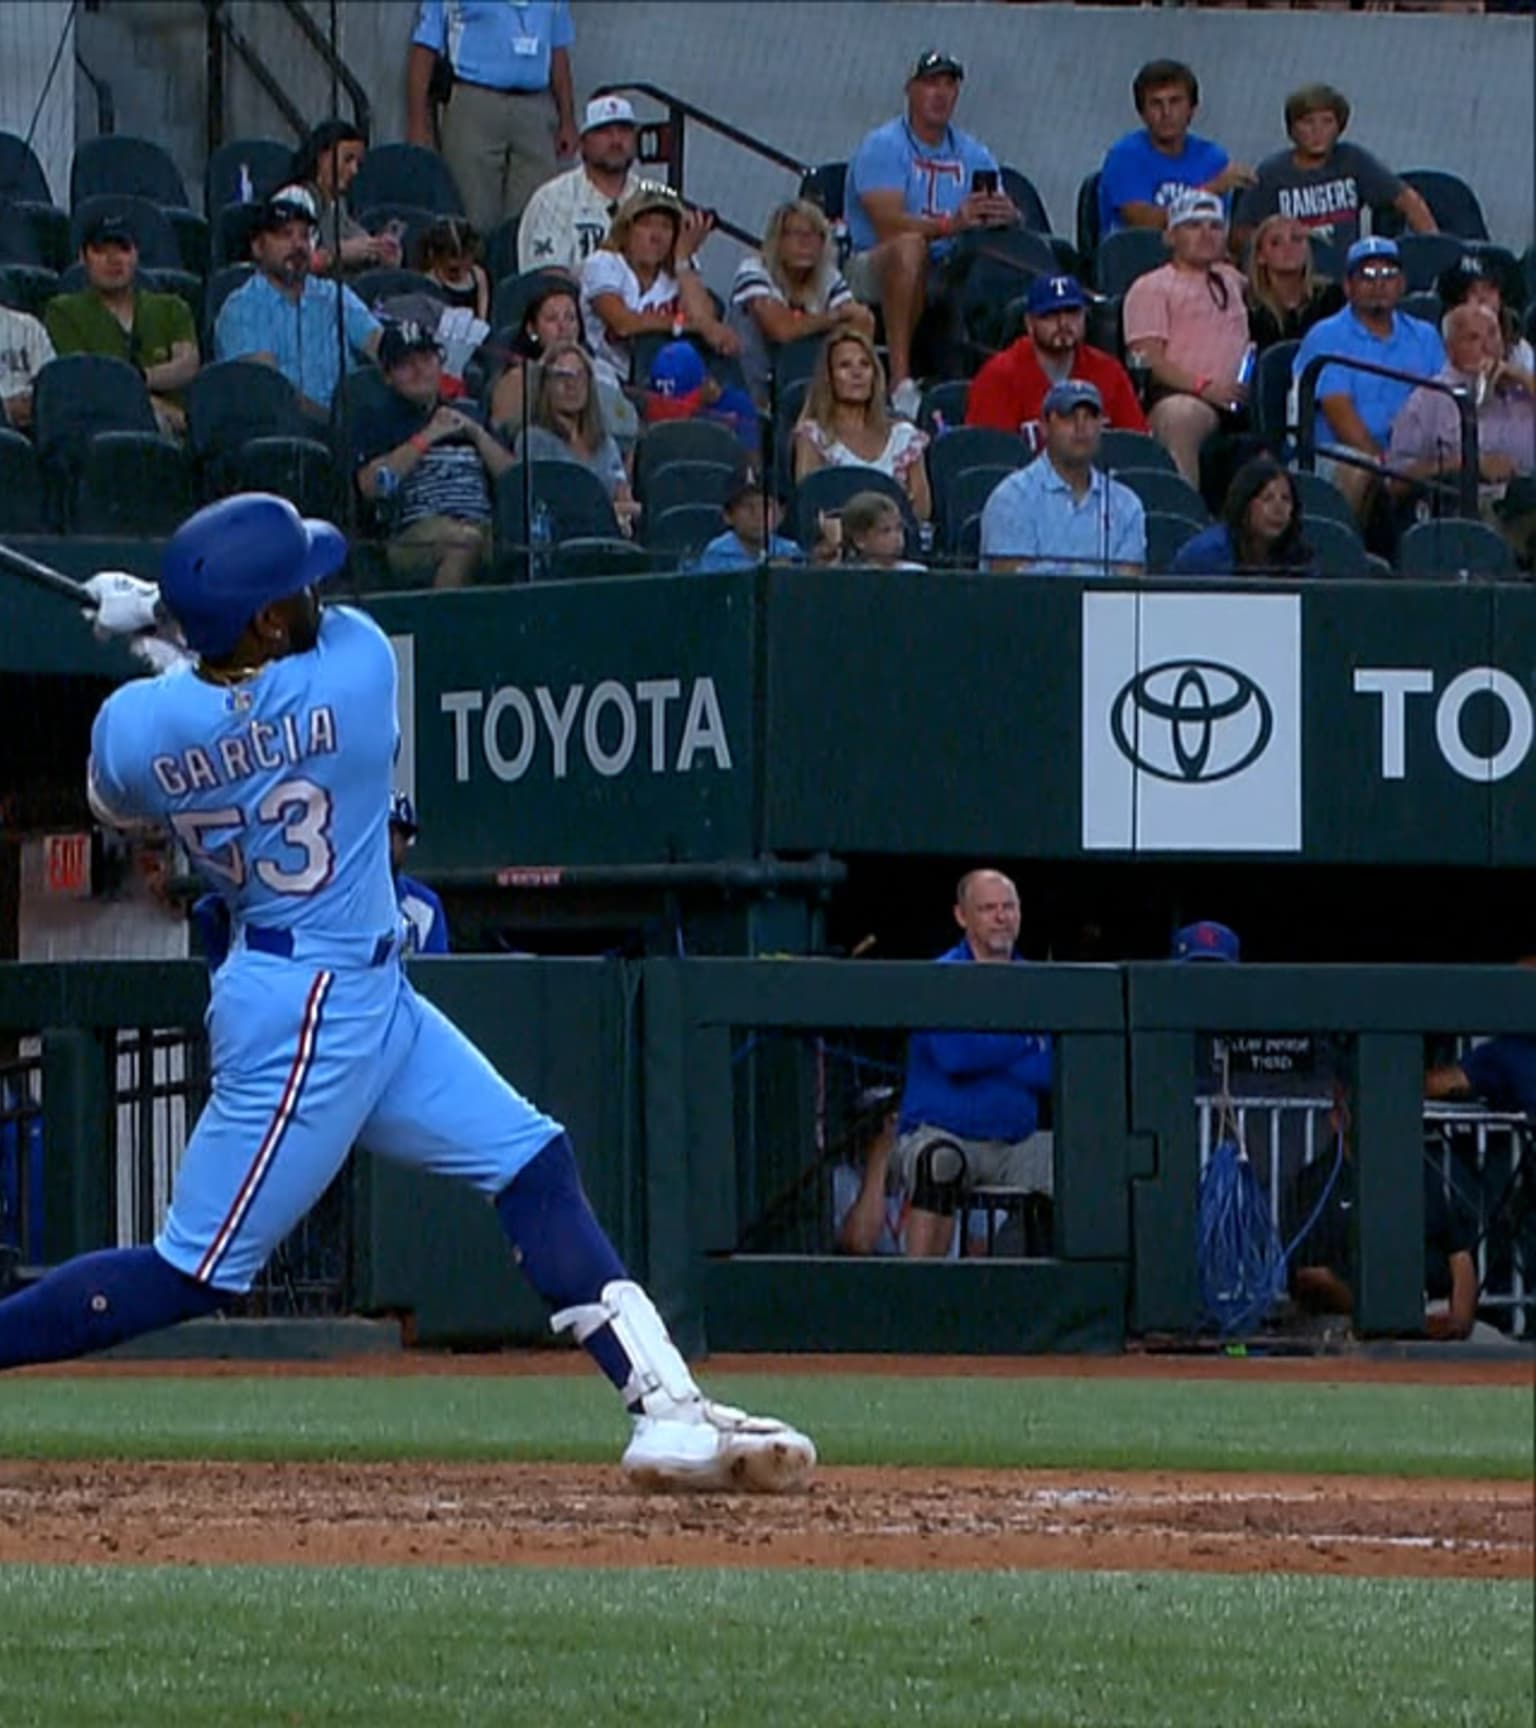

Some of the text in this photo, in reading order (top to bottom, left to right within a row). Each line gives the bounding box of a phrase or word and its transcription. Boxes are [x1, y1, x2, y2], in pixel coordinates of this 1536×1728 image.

[913, 157, 964, 219] T
[1278, 177, 1359, 218] RANGERS
[1050, 276, 1068, 296] T
[441, 677, 733, 782] TOYOTA
[170, 778, 334, 898] 53
